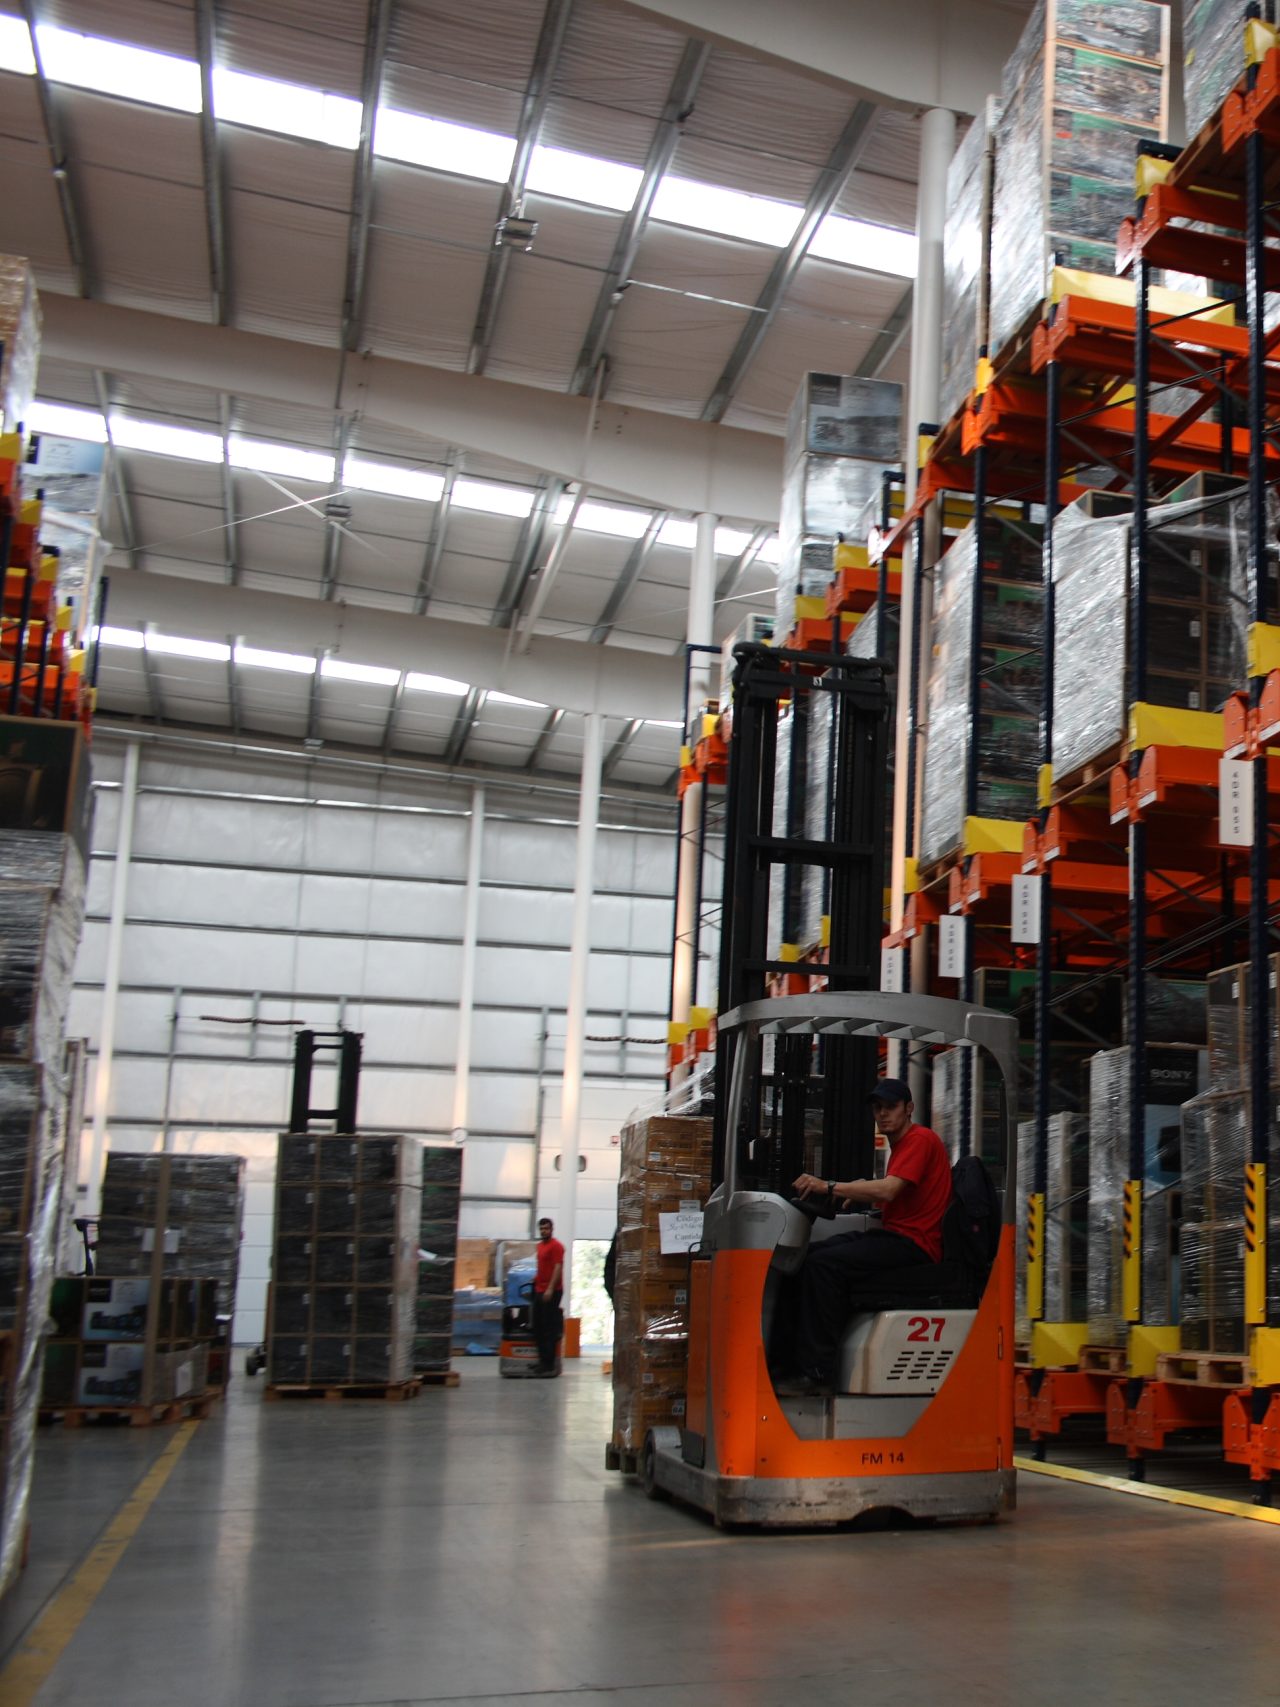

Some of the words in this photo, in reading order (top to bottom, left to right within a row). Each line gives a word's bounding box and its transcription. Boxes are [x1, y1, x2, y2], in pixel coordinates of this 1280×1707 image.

[1150, 1068, 1192, 1080] SONY
[907, 1317, 946, 1342] 27
[861, 1453, 883, 1465] FM
[889, 1452, 905, 1464] 14
